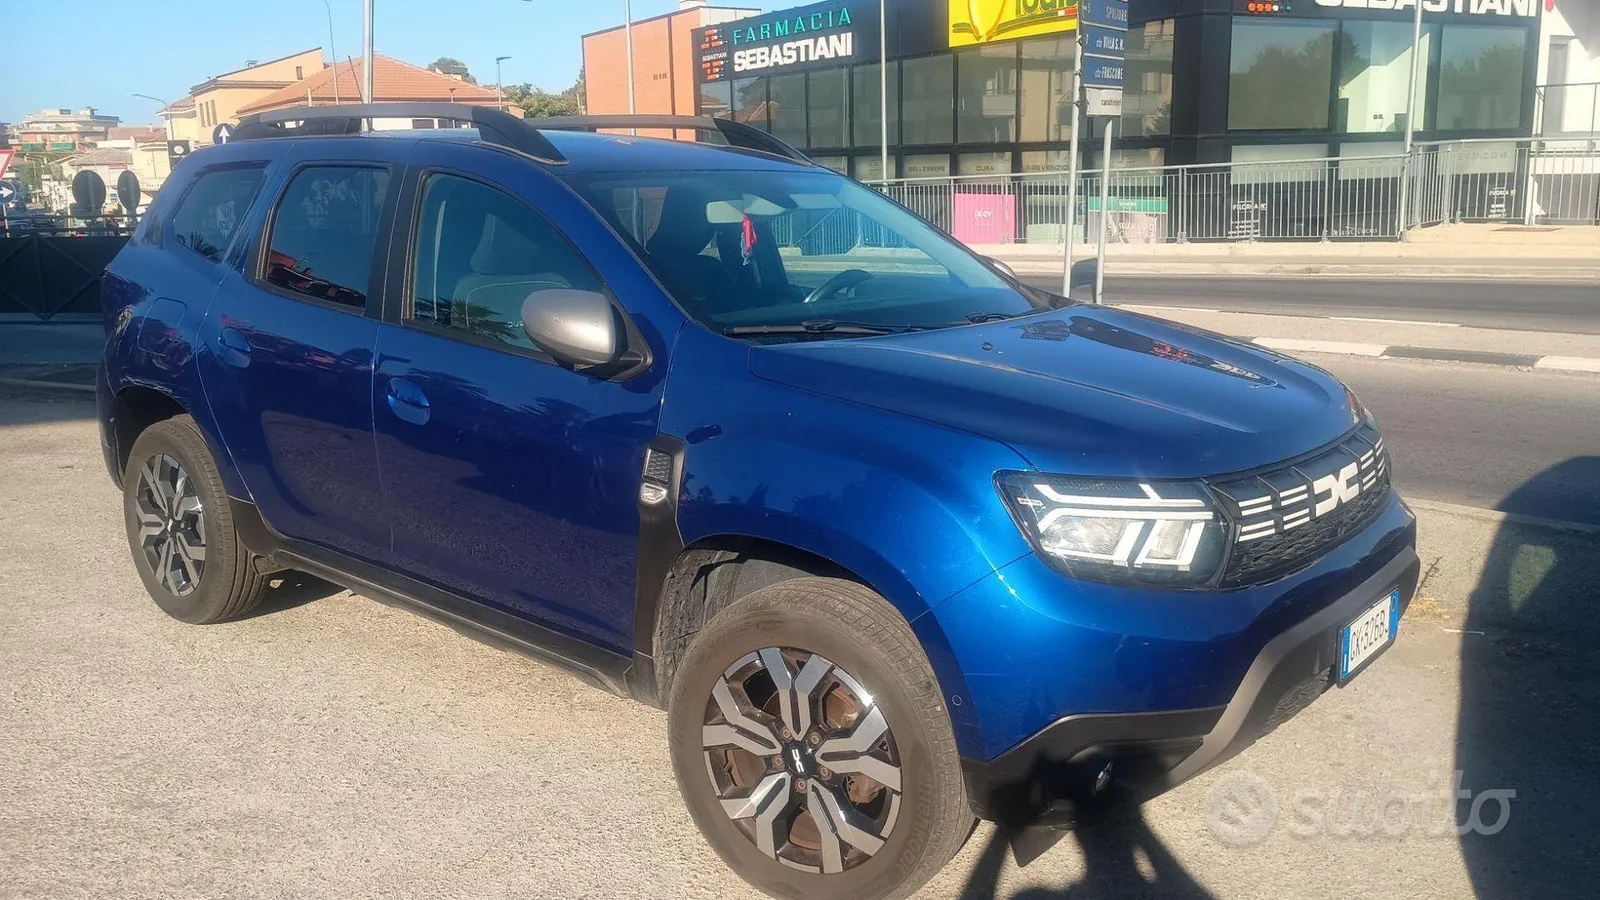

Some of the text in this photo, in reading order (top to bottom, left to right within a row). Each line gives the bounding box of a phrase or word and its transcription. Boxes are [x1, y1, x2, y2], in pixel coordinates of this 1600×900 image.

[733, 7, 851, 45] FARMACIA
[1312, 0, 1538, 17] TIANI
[733, 32, 853, 72] SEBASTIANI
